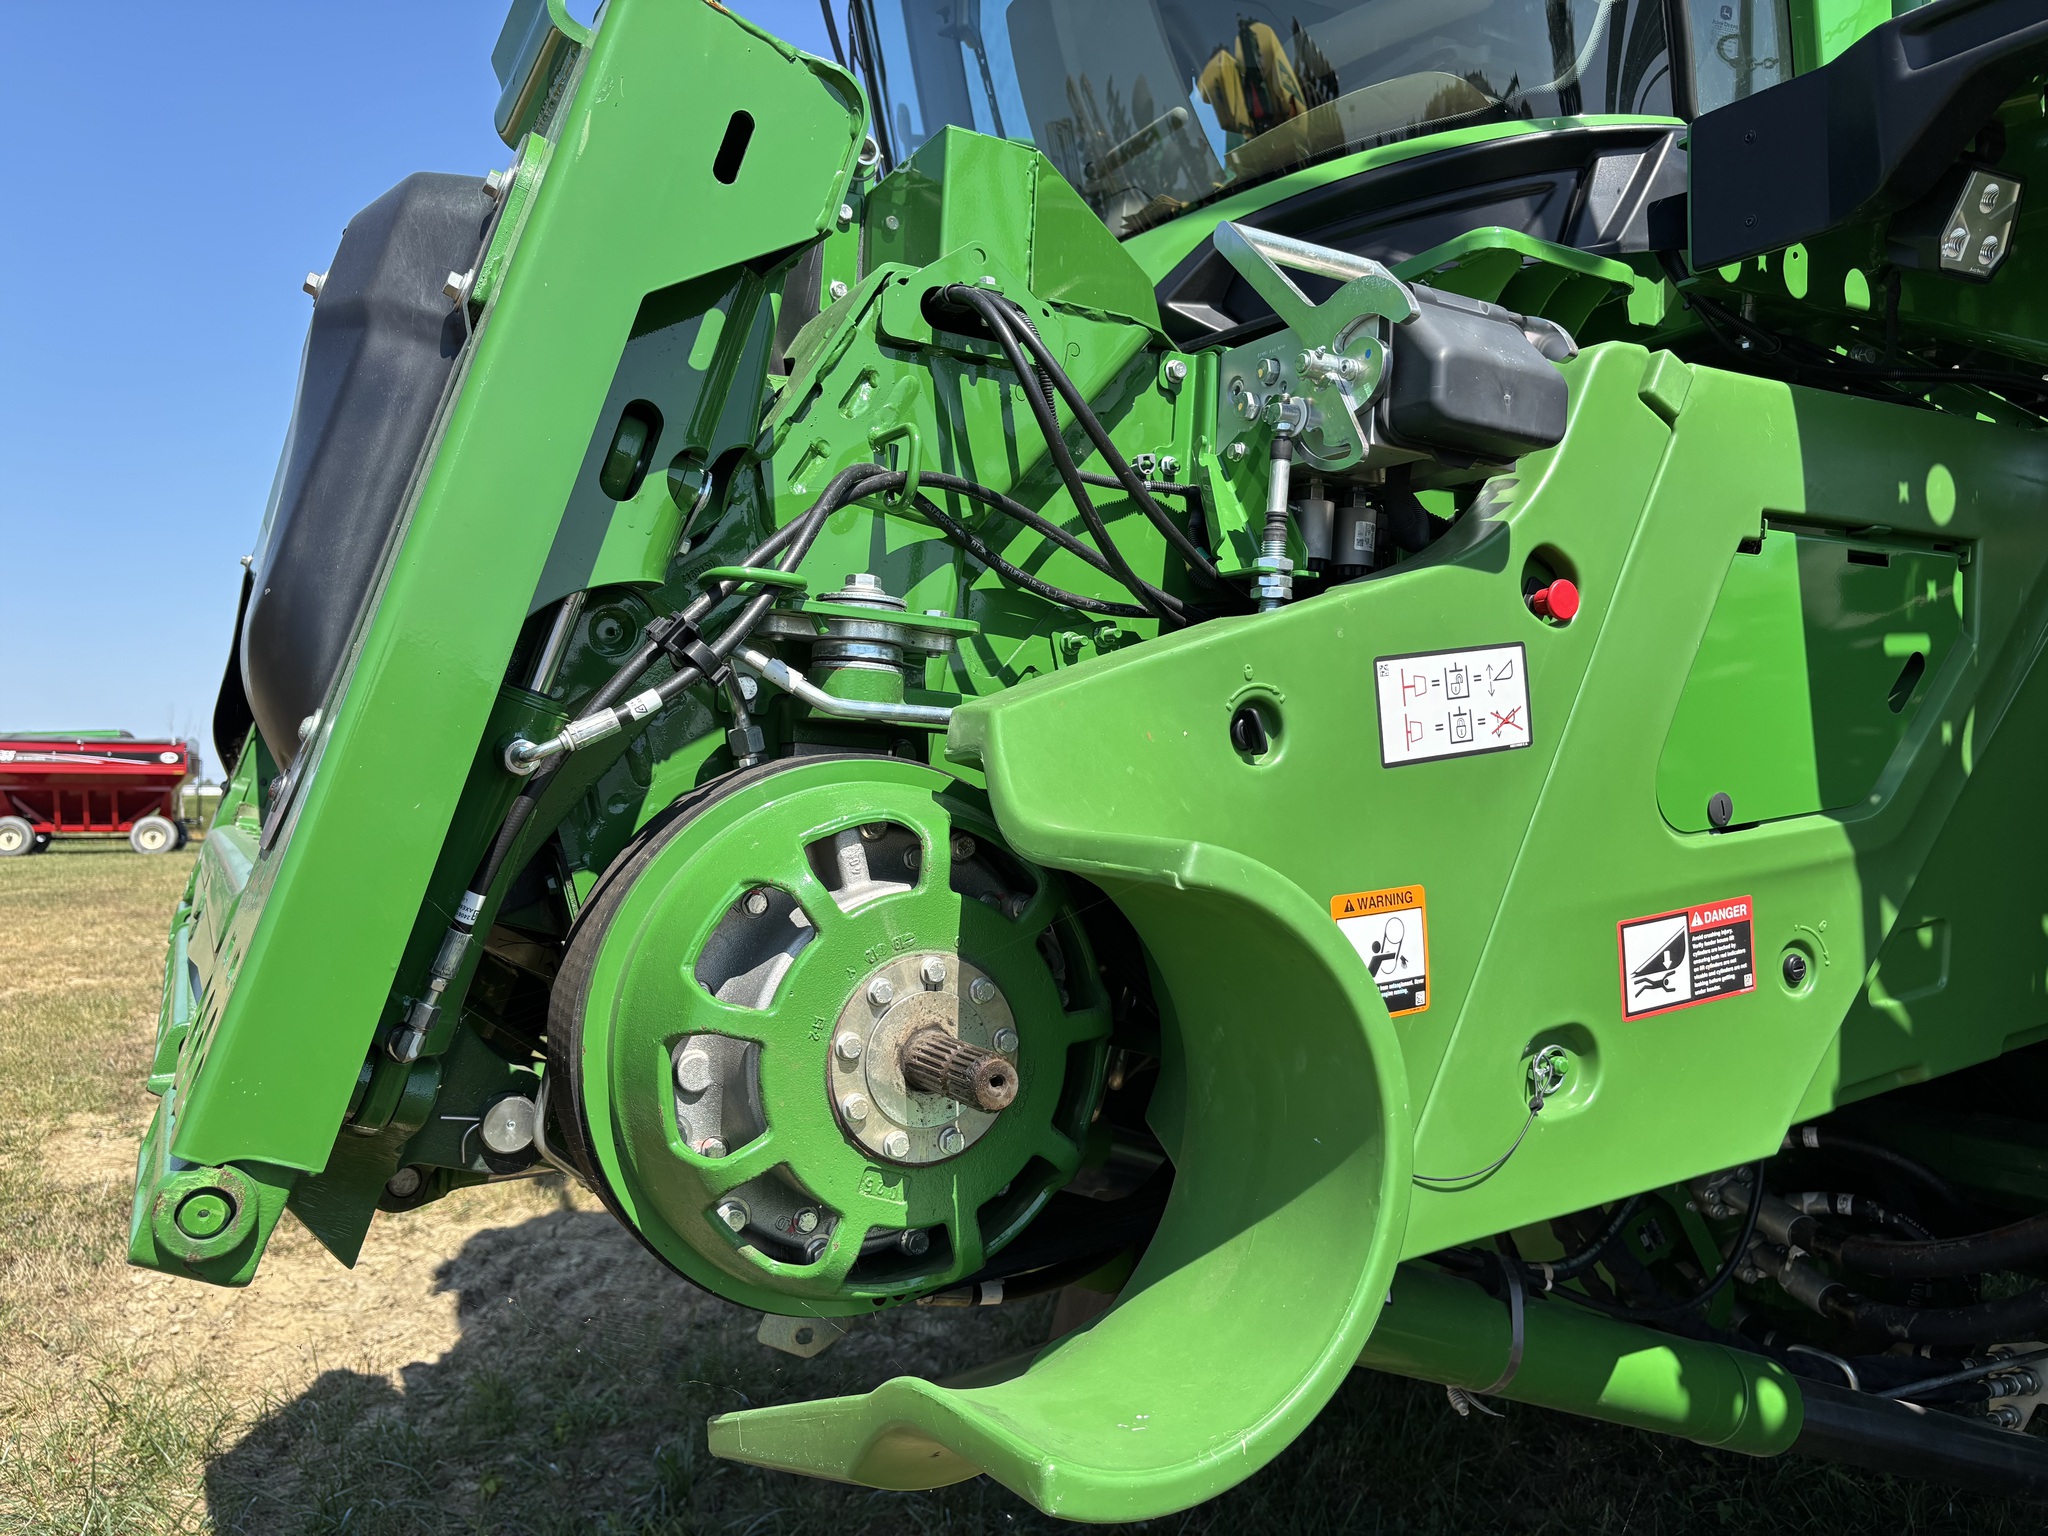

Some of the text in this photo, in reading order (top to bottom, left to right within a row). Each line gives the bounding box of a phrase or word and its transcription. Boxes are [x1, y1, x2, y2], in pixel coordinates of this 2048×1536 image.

[1357, 891, 1413, 910] WARNING
[1704, 904, 1747, 923] DANGER
[1693, 949, 1710, 957] cylinders
[1706, 962, 1723, 970] cylinders
[1716, 967, 1733, 975] cylinders
